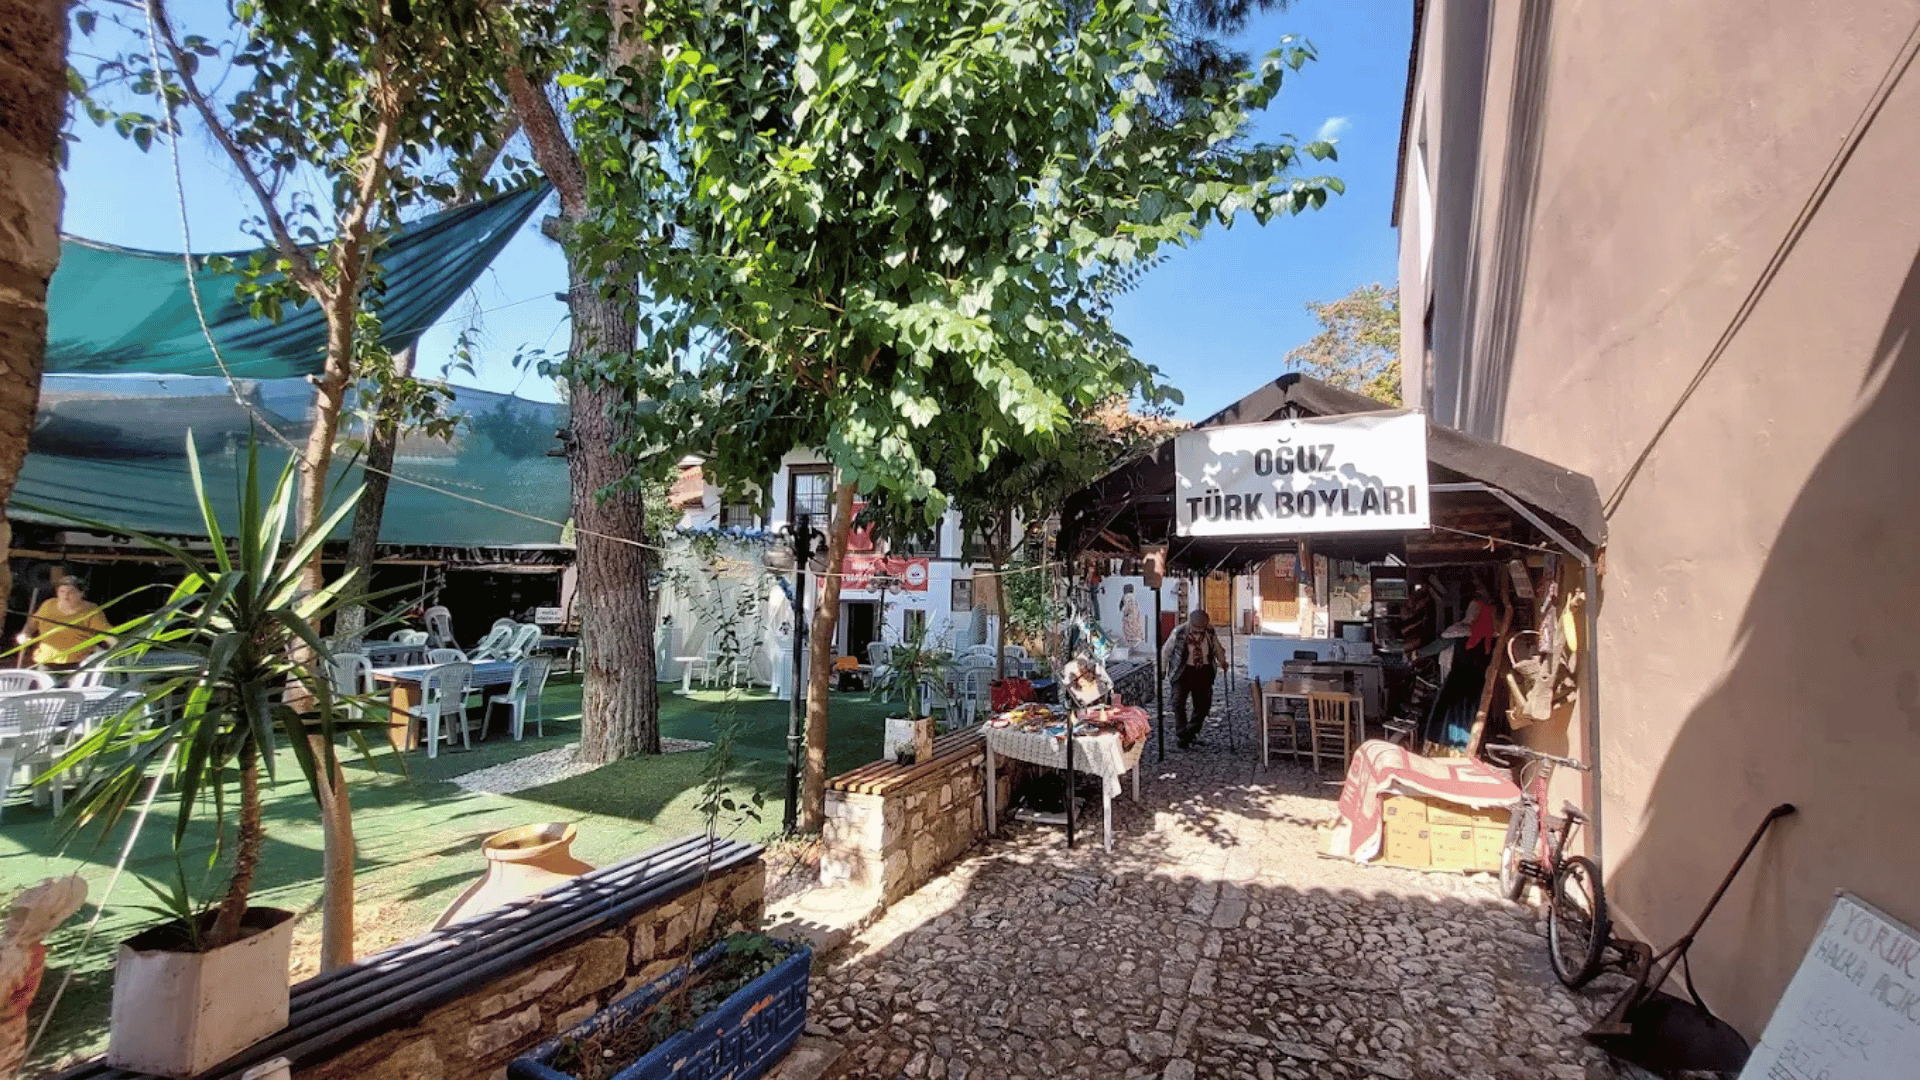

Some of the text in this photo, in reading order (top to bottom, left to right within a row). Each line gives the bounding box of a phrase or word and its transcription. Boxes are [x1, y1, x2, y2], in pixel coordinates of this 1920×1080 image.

[1254, 437, 1336, 477] OĞUZ
[1186, 484, 1417, 522] TÜRK BOYLARI
